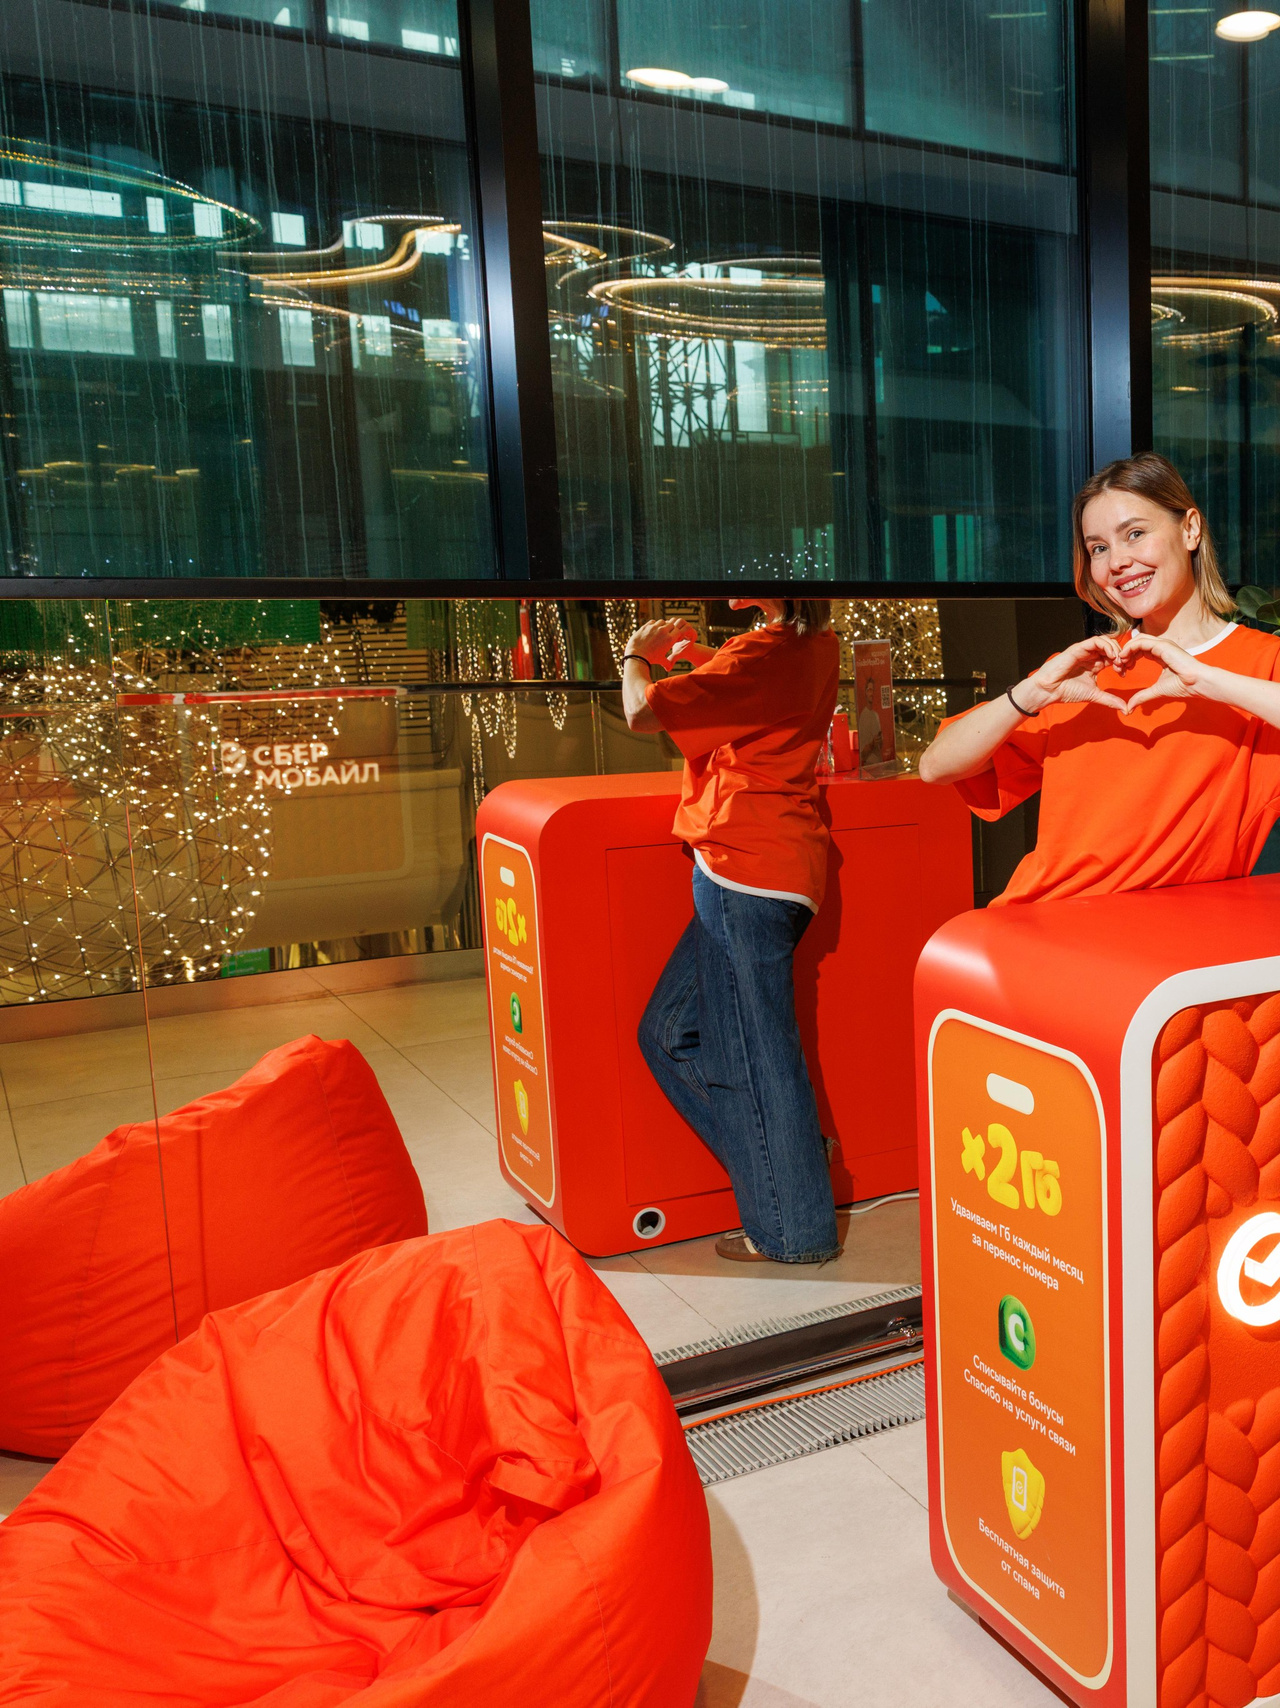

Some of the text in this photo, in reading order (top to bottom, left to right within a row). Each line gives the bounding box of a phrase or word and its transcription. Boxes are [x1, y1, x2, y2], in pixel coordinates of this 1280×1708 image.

[253, 743, 329, 766] СБЕР
[256, 760, 379, 790] МОБАЙЛ
[951, 1197, 1084, 1284] Удваиваем Гб каждый месяц
[972, 1233, 1059, 1290] за перенос номера
[964, 1368, 1076, 1456] Спасибо на услуги связи
[973, 1354, 1064, 1426] Списывайте бонусы
[978, 1517, 1065, 1599] Бесплатная защита
[1001, 1559, 1040, 1600] от спама
